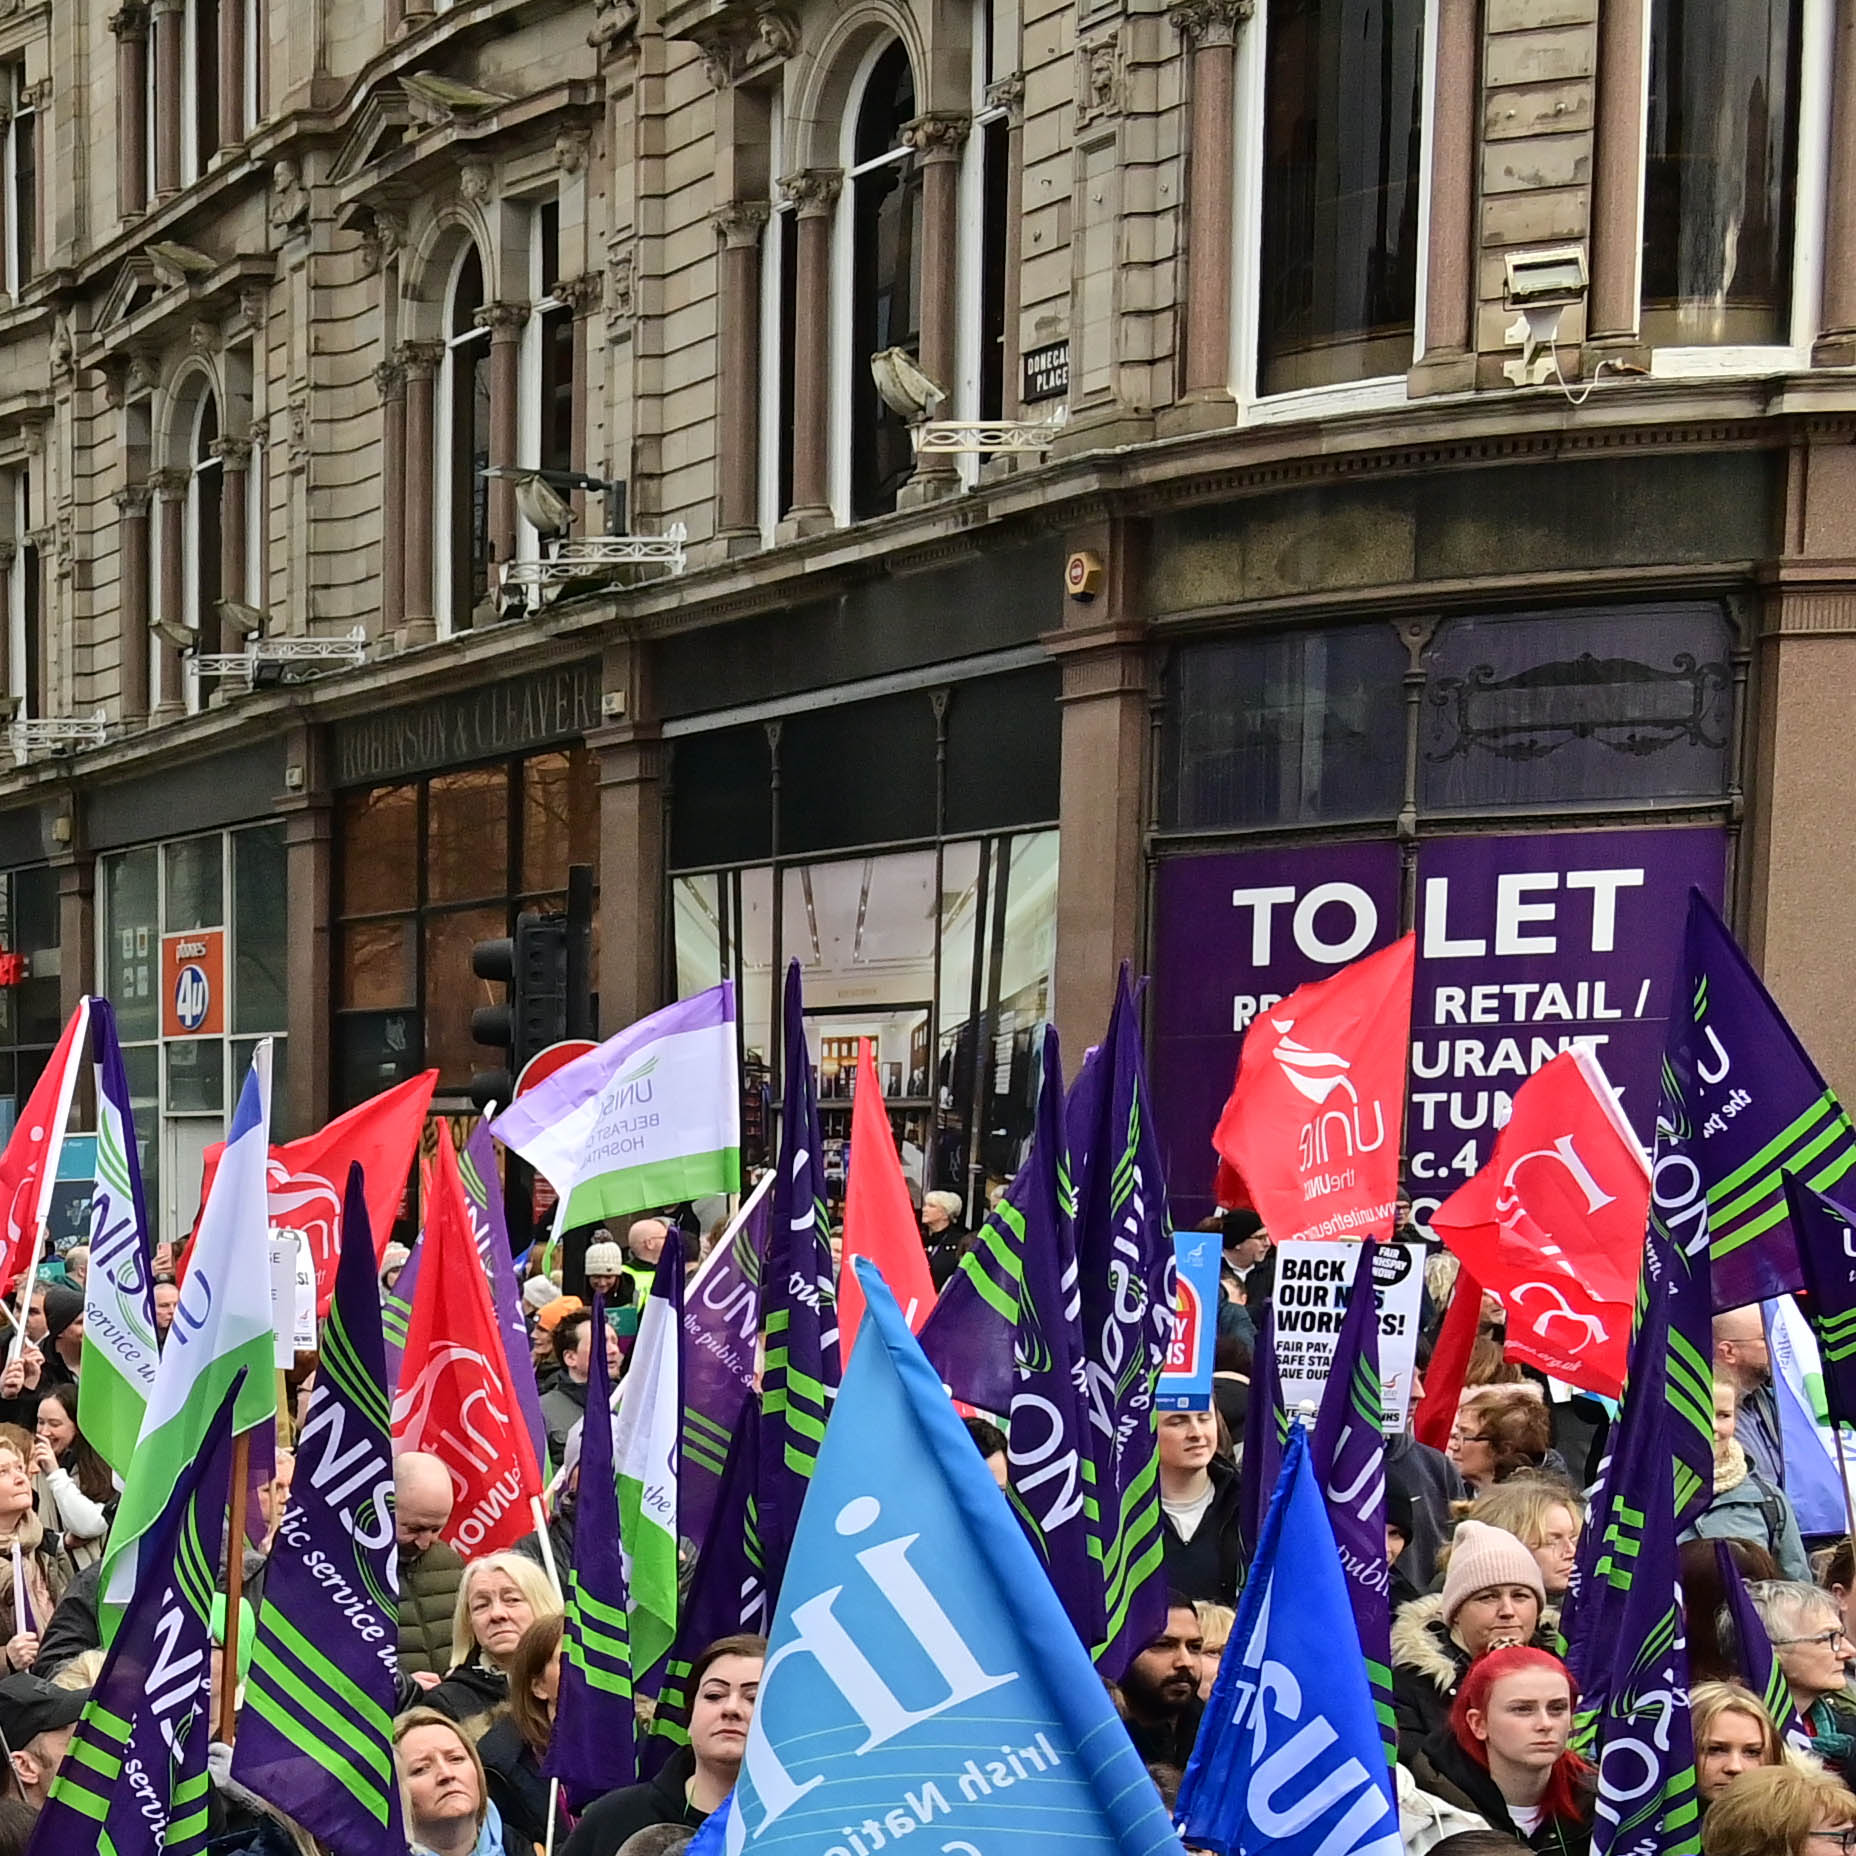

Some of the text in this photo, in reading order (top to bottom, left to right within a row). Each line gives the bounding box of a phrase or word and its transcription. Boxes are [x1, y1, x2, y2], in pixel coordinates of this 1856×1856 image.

[1037, 366, 1068, 393] PLACE
[475, 669, 589, 752] CLEAVER
[1233, 868, 1645, 968] TO LET
[176, 939, 207, 964] phones
[1435, 980, 1622, 1025] RETAIL
[1281, 1258, 1346, 1282] BACK
[1279, 1285, 1329, 1307] OUR
[696, 1333, 742, 1375] public
[1275, 1340, 1333, 1355] FAIR PAY,
[1275, 1354, 1305, 1367] SAFE
[1280, 1367, 1304, 1380] AVE
[643, 1484, 672, 1514] the
[1336, 1544, 1388, 1597] publi
[301, 1544, 386, 1643] service
